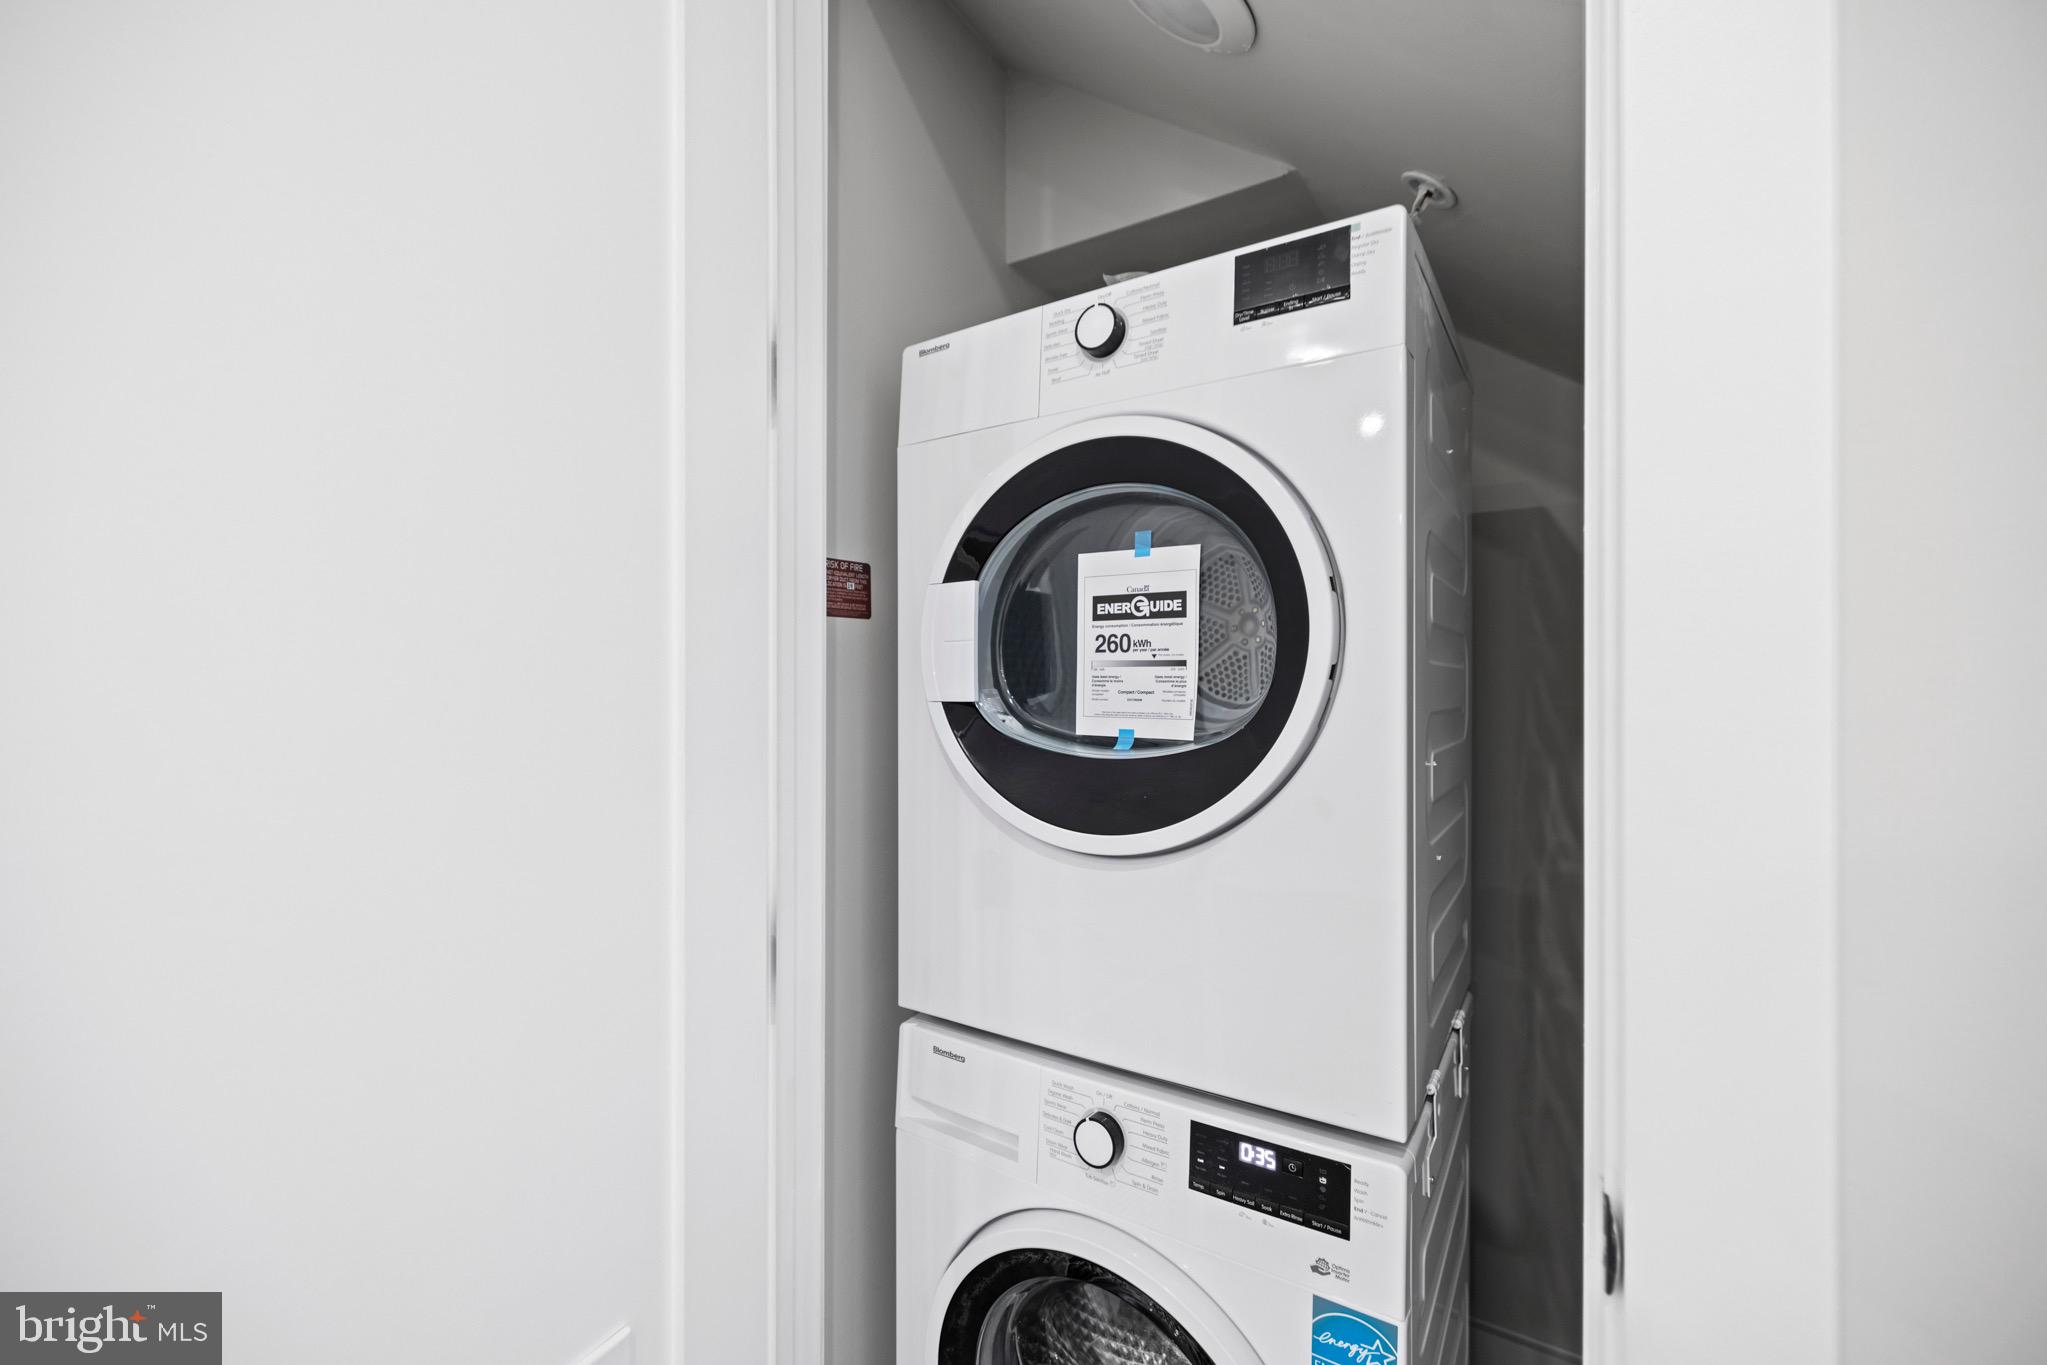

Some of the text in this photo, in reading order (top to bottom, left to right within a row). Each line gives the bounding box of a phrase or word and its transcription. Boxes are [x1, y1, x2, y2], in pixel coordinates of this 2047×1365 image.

[1096, 595, 1183, 617] ENERGUIDE
[1095, 633, 1132, 653] 260
[1133, 639, 1152, 648] kWh
